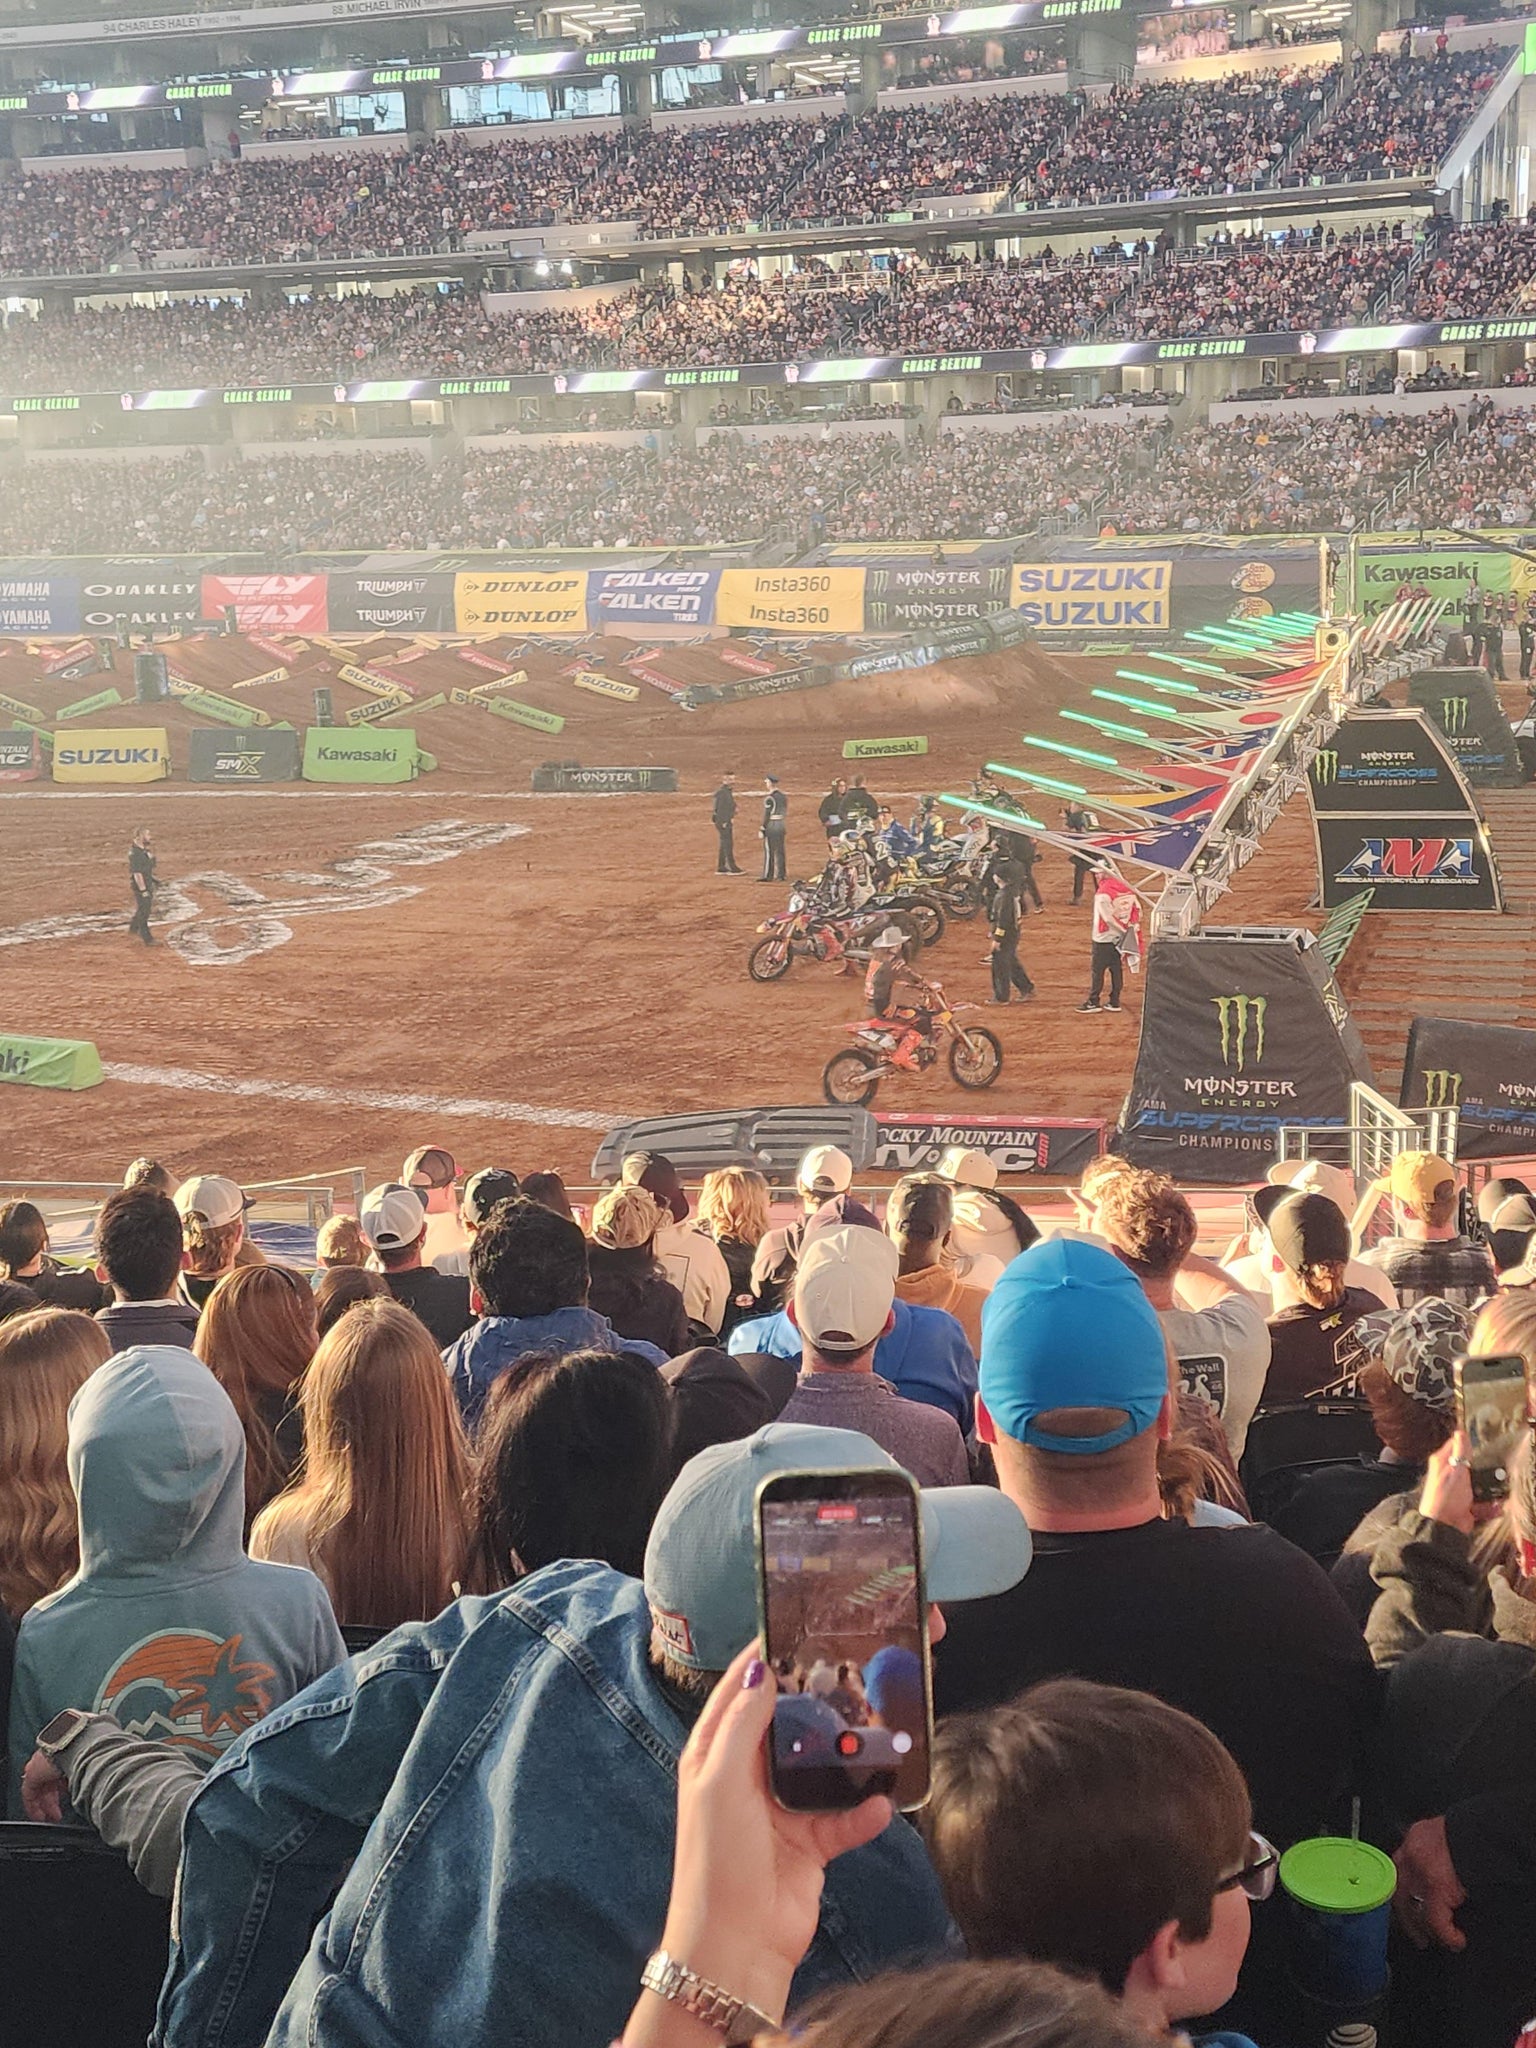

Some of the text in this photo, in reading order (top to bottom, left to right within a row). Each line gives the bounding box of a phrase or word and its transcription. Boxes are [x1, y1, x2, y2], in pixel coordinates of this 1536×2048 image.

[346, 1, 393, 13] MICHAEL
[1042, 1, 1079, 19] CHASE
[103, 24, 116, 34] 94
[118, 19, 167, 33] CHARLES
[168, 17, 201, 28] HALEY
[1440, 325, 1483, 341] CHASE
[1158, 343, 1196, 359] CHASE
[902, 358, 937, 372] CHASE
[664, 371, 697, 386] CHASE
[439, 382, 471, 395] CHASE
[602, 571, 710, 588] FALKEN
[895, 569, 981, 587] MONSTER
[1019, 566, 1164, 592] SUZUKI
[1364, 561, 1479, 583] Kawasaki
[2, 582, 50, 597] YAMAHA
[115, 583, 197, 597] OAKLEY
[356, 580, 412, 595] TRIUMPH
[483, 580, 579, 593] DUNLOP
[755, 576, 831, 592] Insta360
[598, 592, 701, 610] FALKEN
[2, 610, 51, 625] YAMAHA
[356, 609, 413, 625] TRIUMPH
[483, 610, 577, 623] DUNLOP
[750, 605, 829, 624] Insta360
[895, 600, 980, 619] MONSTER
[1019, 601, 1162, 626] SUZUKI
[344, 668, 394, 693] SUZUKI
[580, 675, 634, 696] SUZUKI
[350, 695, 401, 721] SUZUKI
[499, 701, 555, 726] Kawasaki
[58, 748, 159, 765] SUZUKI
[317, 747, 398, 762] Kawasaki
[855, 741, 919, 756] Kawasaki
[1360, 751, 1416, 761] MONSTER
[570, 771, 634, 783] MONSTER
[1338, 768, 1438, 778] SUPERCROSS
[1334, 838, 1480, 877] AMA
[1184, 1076, 1298, 1098] MONSTER
[1144, 1099, 1167, 1111] AMA
[1201, 1098, 1280, 1109] ENERGY
[1465, 1097, 1483, 1105] AMA
[926, 1126, 1038, 1147] MOUNTAIN
[1181, 1362, 1221, 1375] he Wall
